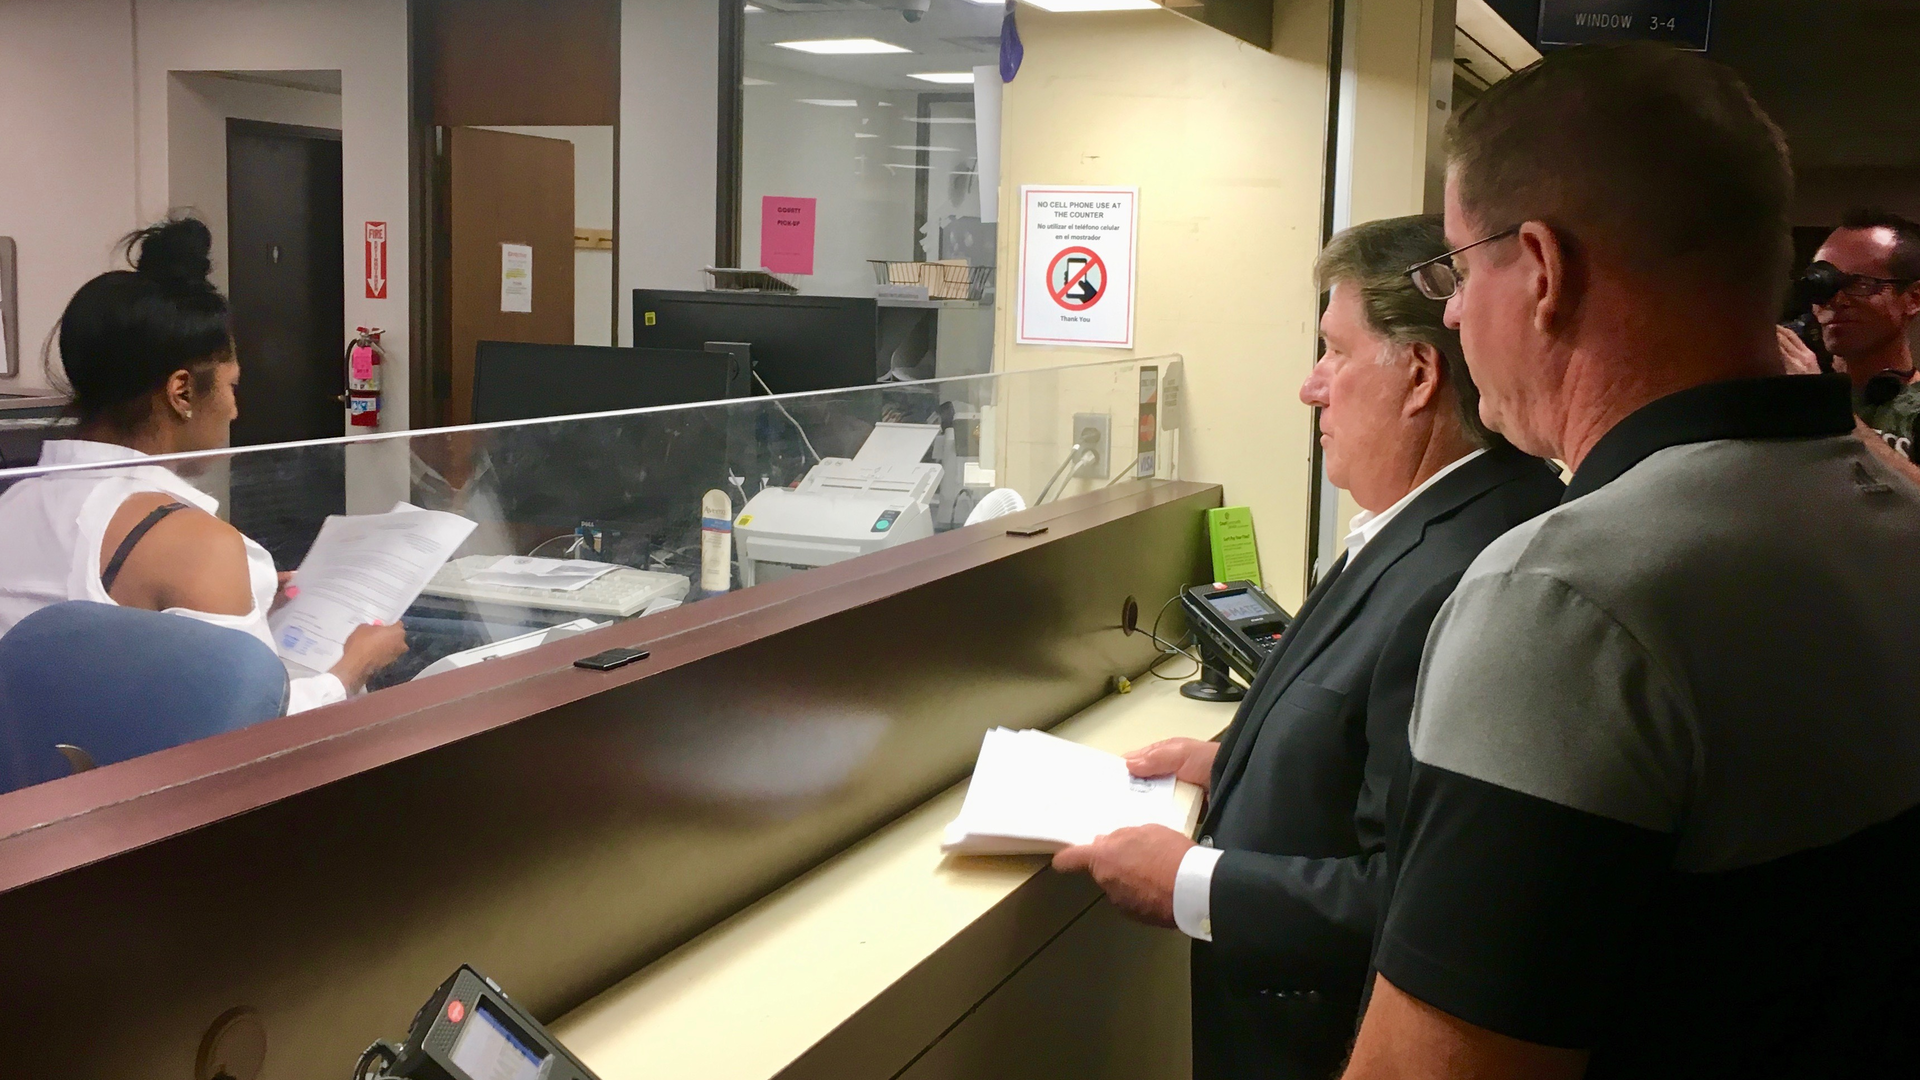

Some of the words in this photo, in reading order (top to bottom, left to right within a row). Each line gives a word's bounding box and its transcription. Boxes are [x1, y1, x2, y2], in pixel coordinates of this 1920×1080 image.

[1575, 13, 1632, 29] WINDOW
[1649, 16, 1676, 31] 3-4
[1069, 211, 1104, 219] COUNTER
[368, 228, 383, 239] FIRE
[1140, 455, 1154, 473] VISA
